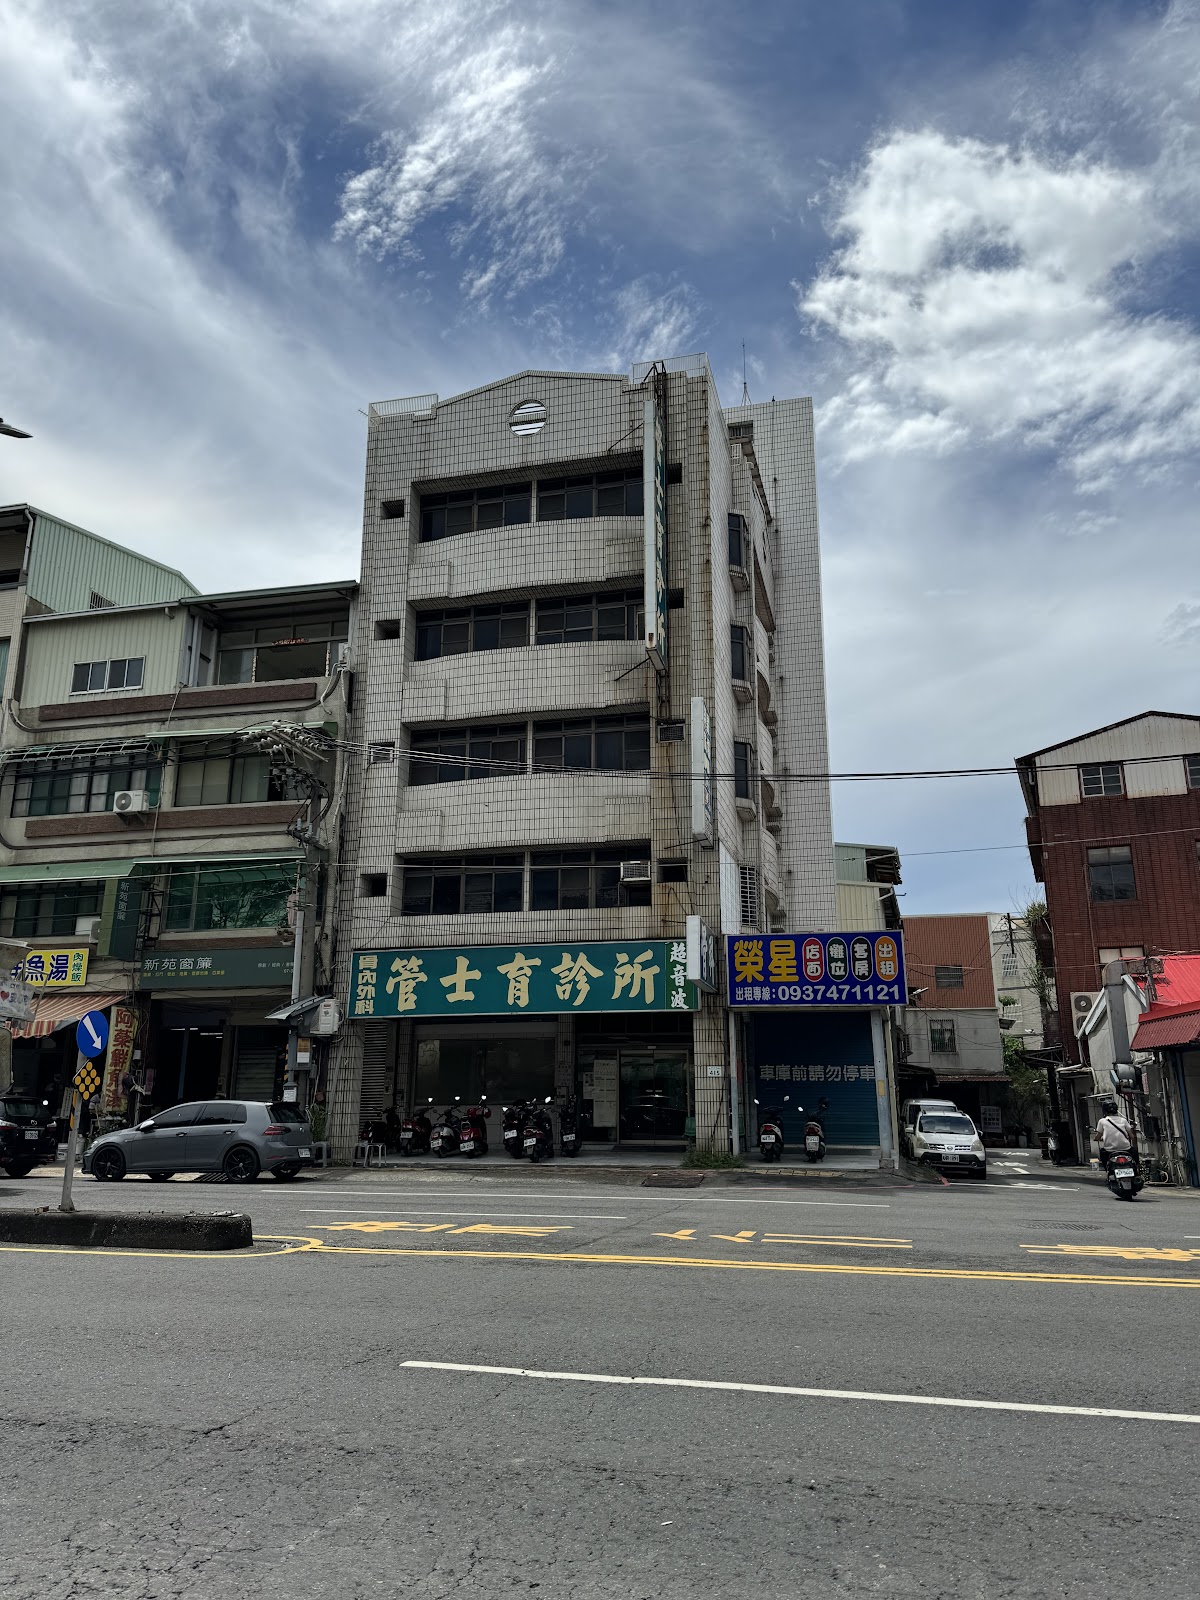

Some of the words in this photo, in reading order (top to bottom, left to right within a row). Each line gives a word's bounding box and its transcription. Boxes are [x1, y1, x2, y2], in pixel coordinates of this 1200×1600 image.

[71, 952, 84, 982] 肉燥飯
[669, 941, 689, 1010] 超音波
[733, 939, 799, 983] 榮星
[806, 944, 822, 976] 店面
[829, 943, 846, 976] 攤位
[853, 943, 870, 976] 客房
[878, 943, 895, 976] 出租
[354, 955, 378, 1015] 骨內外科
[386, 948, 661, 1013] 管士育診所
[760, 1064, 876, 1082] 車庫前請勿停車
